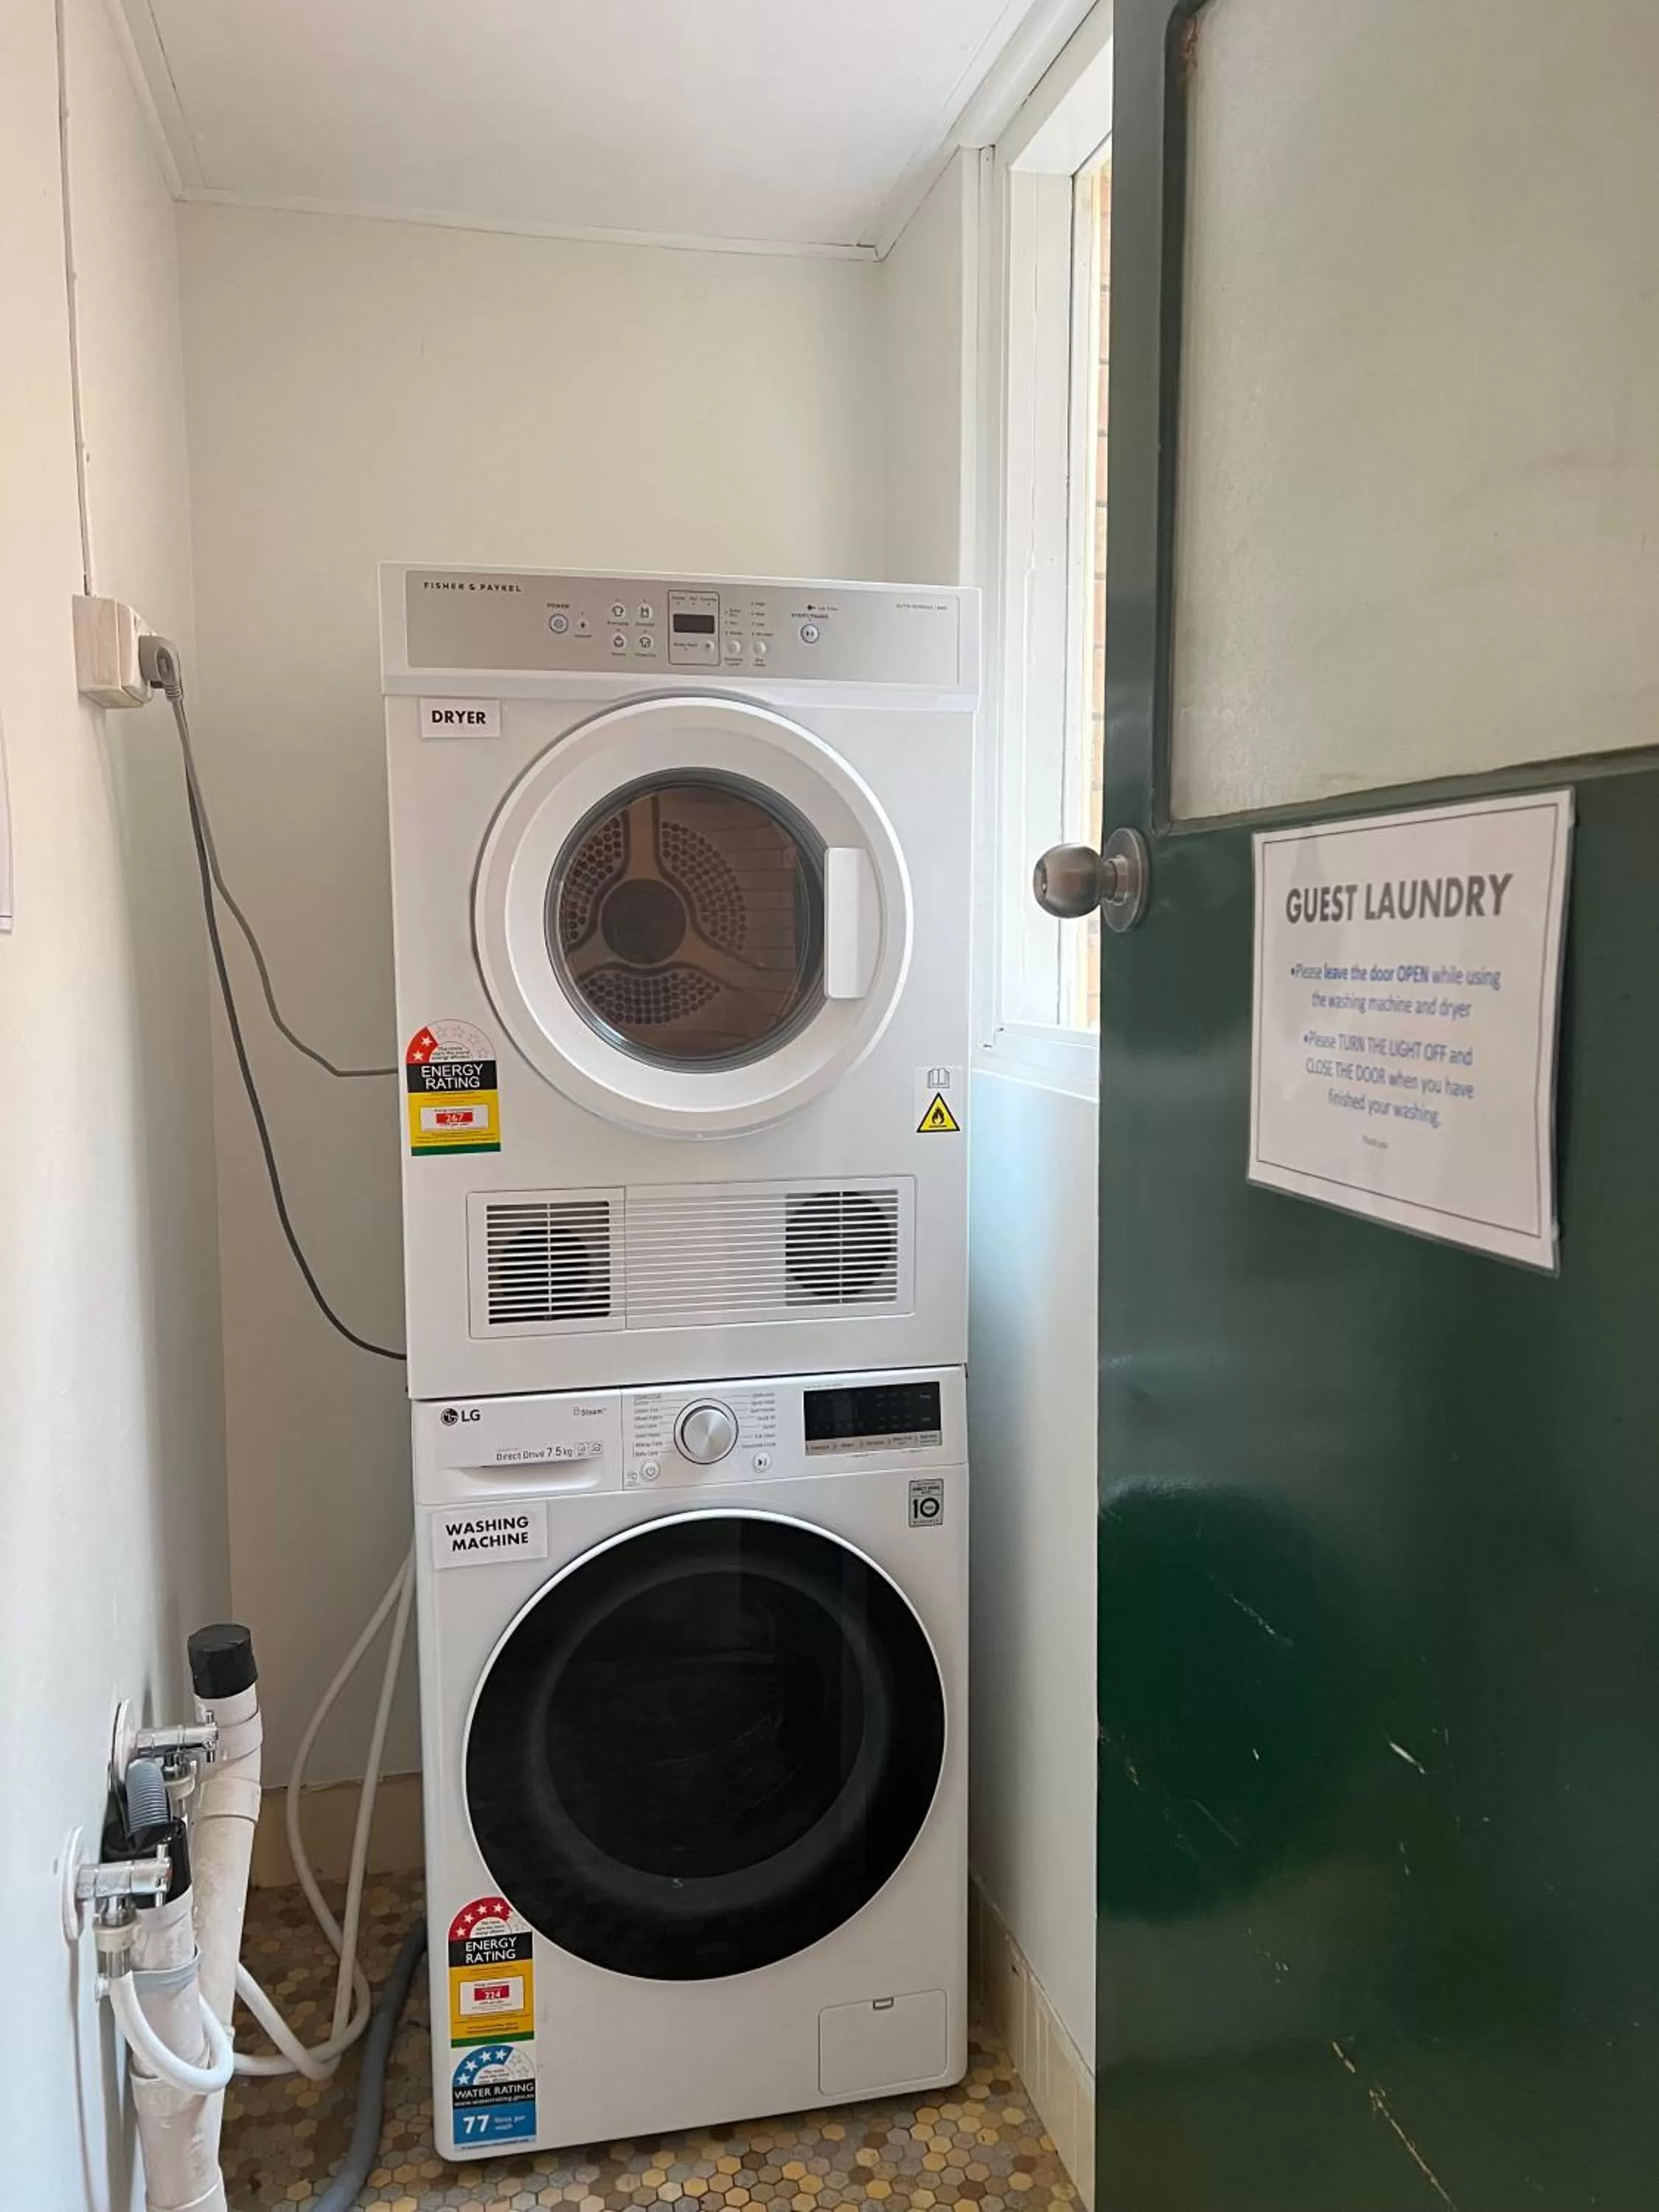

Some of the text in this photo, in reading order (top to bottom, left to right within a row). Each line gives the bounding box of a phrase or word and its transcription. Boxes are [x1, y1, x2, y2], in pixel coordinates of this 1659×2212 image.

[424, 582, 465, 590] FISHER
[480, 583, 521, 592] PAYKEL
[431, 710, 487, 724] DRYER
[1286, 872, 1514, 924] GUEST LAUNDRY
[1324, 961, 1349, 980] leave
[1350, 964, 1367, 981] the
[1369, 963, 1394, 981] door
[1397, 964, 1429, 983] OPEN
[1431, 964, 1464, 985] while
[1465, 966, 1501, 991] using
[1311, 990, 1472, 1021] the washing machine and dryer
[1338, 1033, 1364, 1052] TURN
[1367, 1036, 1387, 1056] THE
[1388, 1038, 1422, 1060] LIGHT
[1423, 1043, 1447, 1062] OFF
[1449, 1046, 1473, 1066] and
[421, 1063, 484, 1077] ENERGY
[1306, 1057, 1475, 1099] CLOSE THE DOOR when you have
[425, 1076, 481, 1090] RATING
[1328, 1088, 1366, 1110] finished
[1367, 1098, 1391, 1116] your
[461, 1409, 481, 1422] LG
[496, 1452, 521, 1461] Direct
[523, 1450, 545, 1459] Drive
[913, 1498, 940, 1519] 10
[445, 1516, 529, 1536] WASHING
[452, 1532, 529, 1551] MACHINE
[465, 1936, 517, 1952] ENERGY
[465, 1949, 516, 1964] RATING
[453, 2082, 535, 2100] WATER RATING
[463, 2113, 490, 2135] 77
